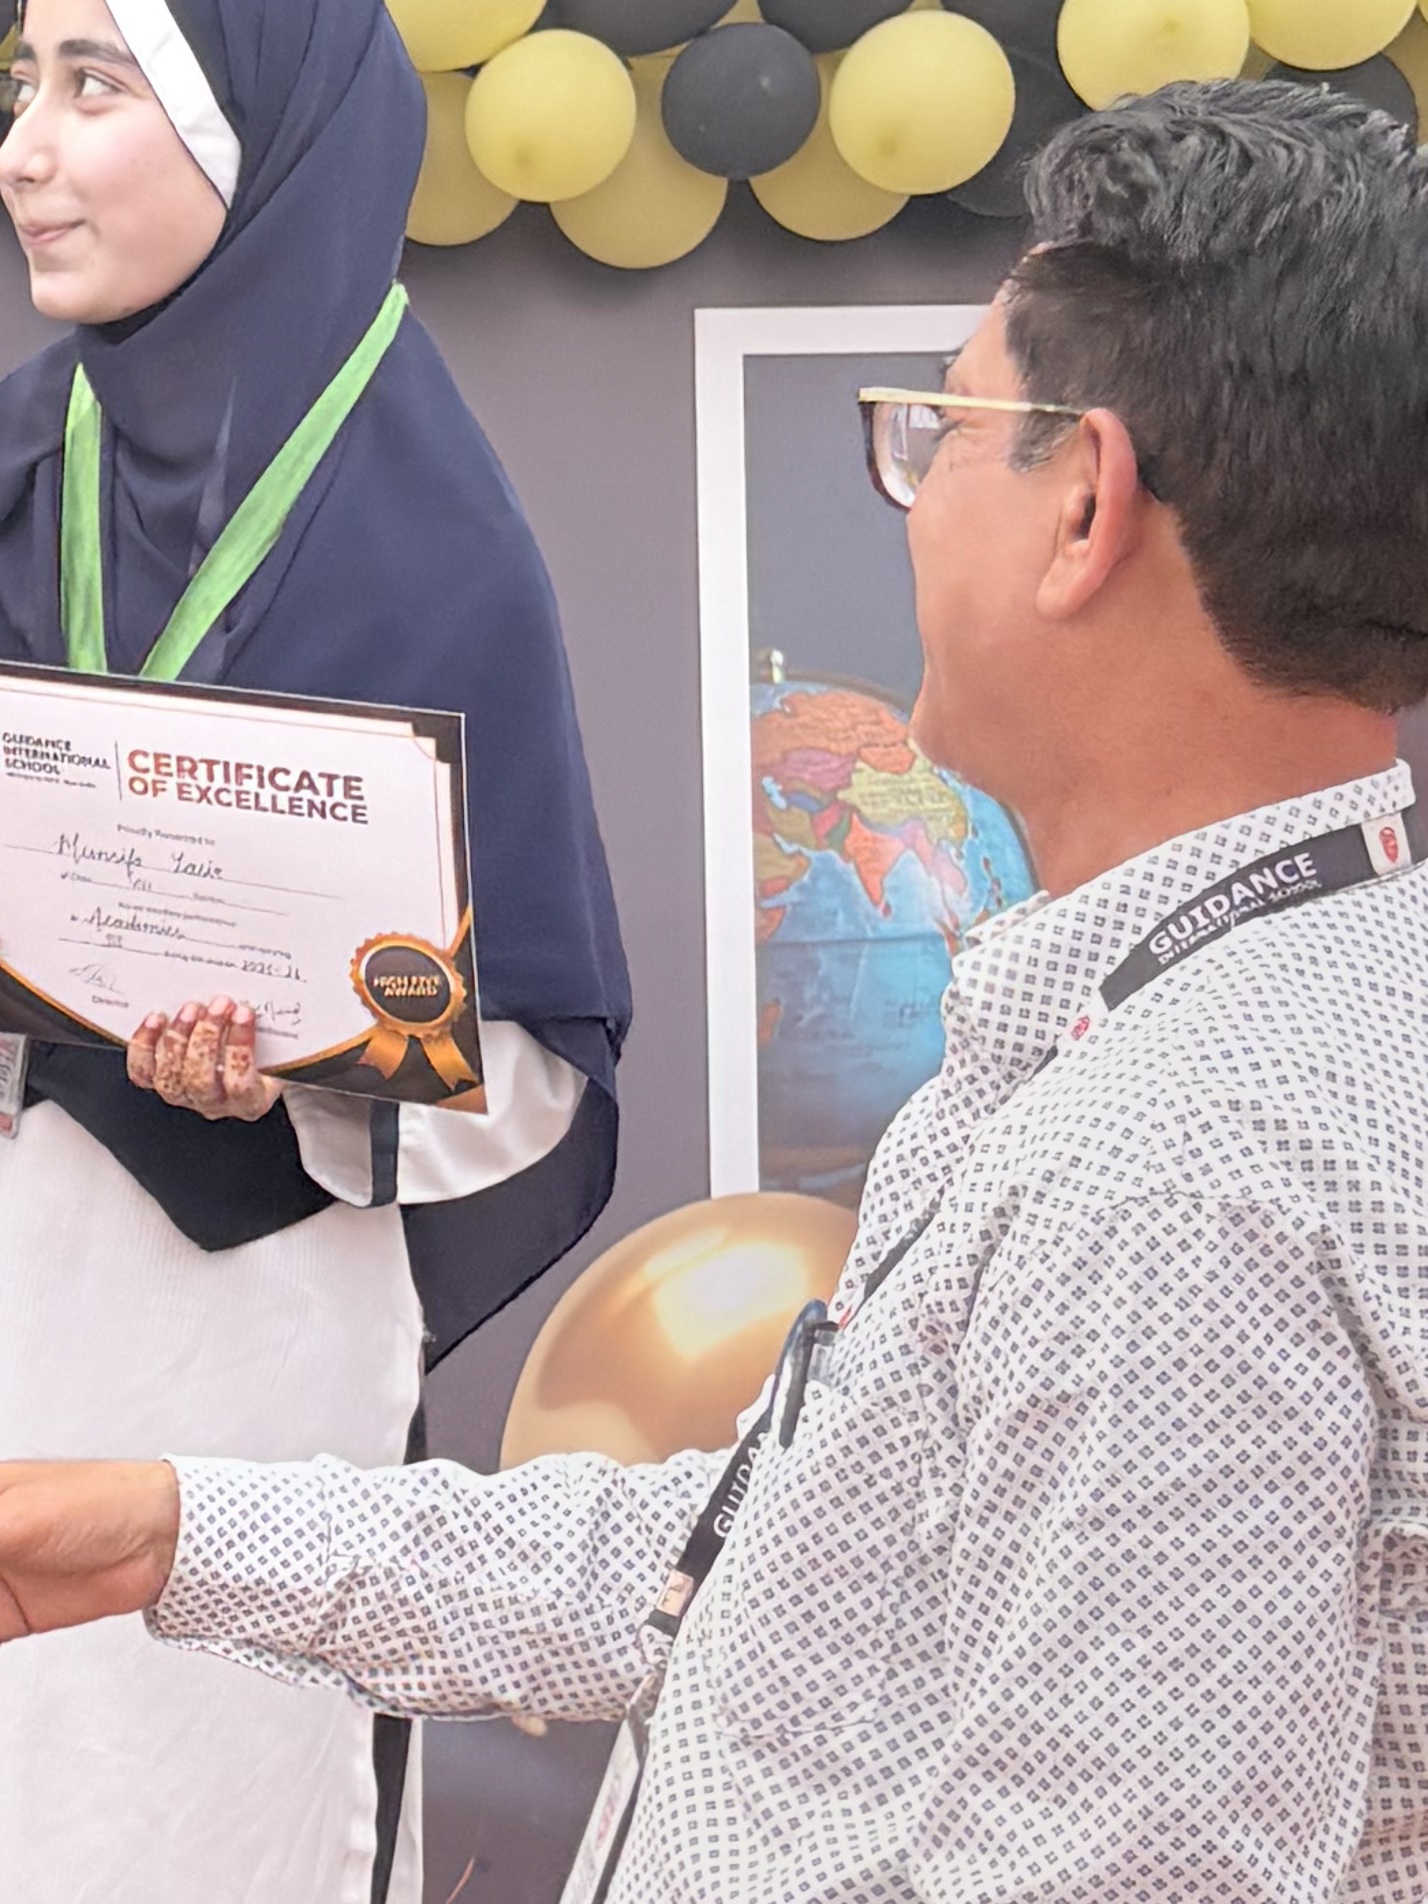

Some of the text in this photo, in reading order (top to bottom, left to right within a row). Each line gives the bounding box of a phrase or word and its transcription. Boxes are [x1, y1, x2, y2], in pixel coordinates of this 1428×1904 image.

[127, 749, 366, 802] CERTIFICATE
[128, 775, 168, 797] OF
[177, 782, 369, 825] EXCELLENCE
[1147, 851, 1317, 956] GUIDANCE
